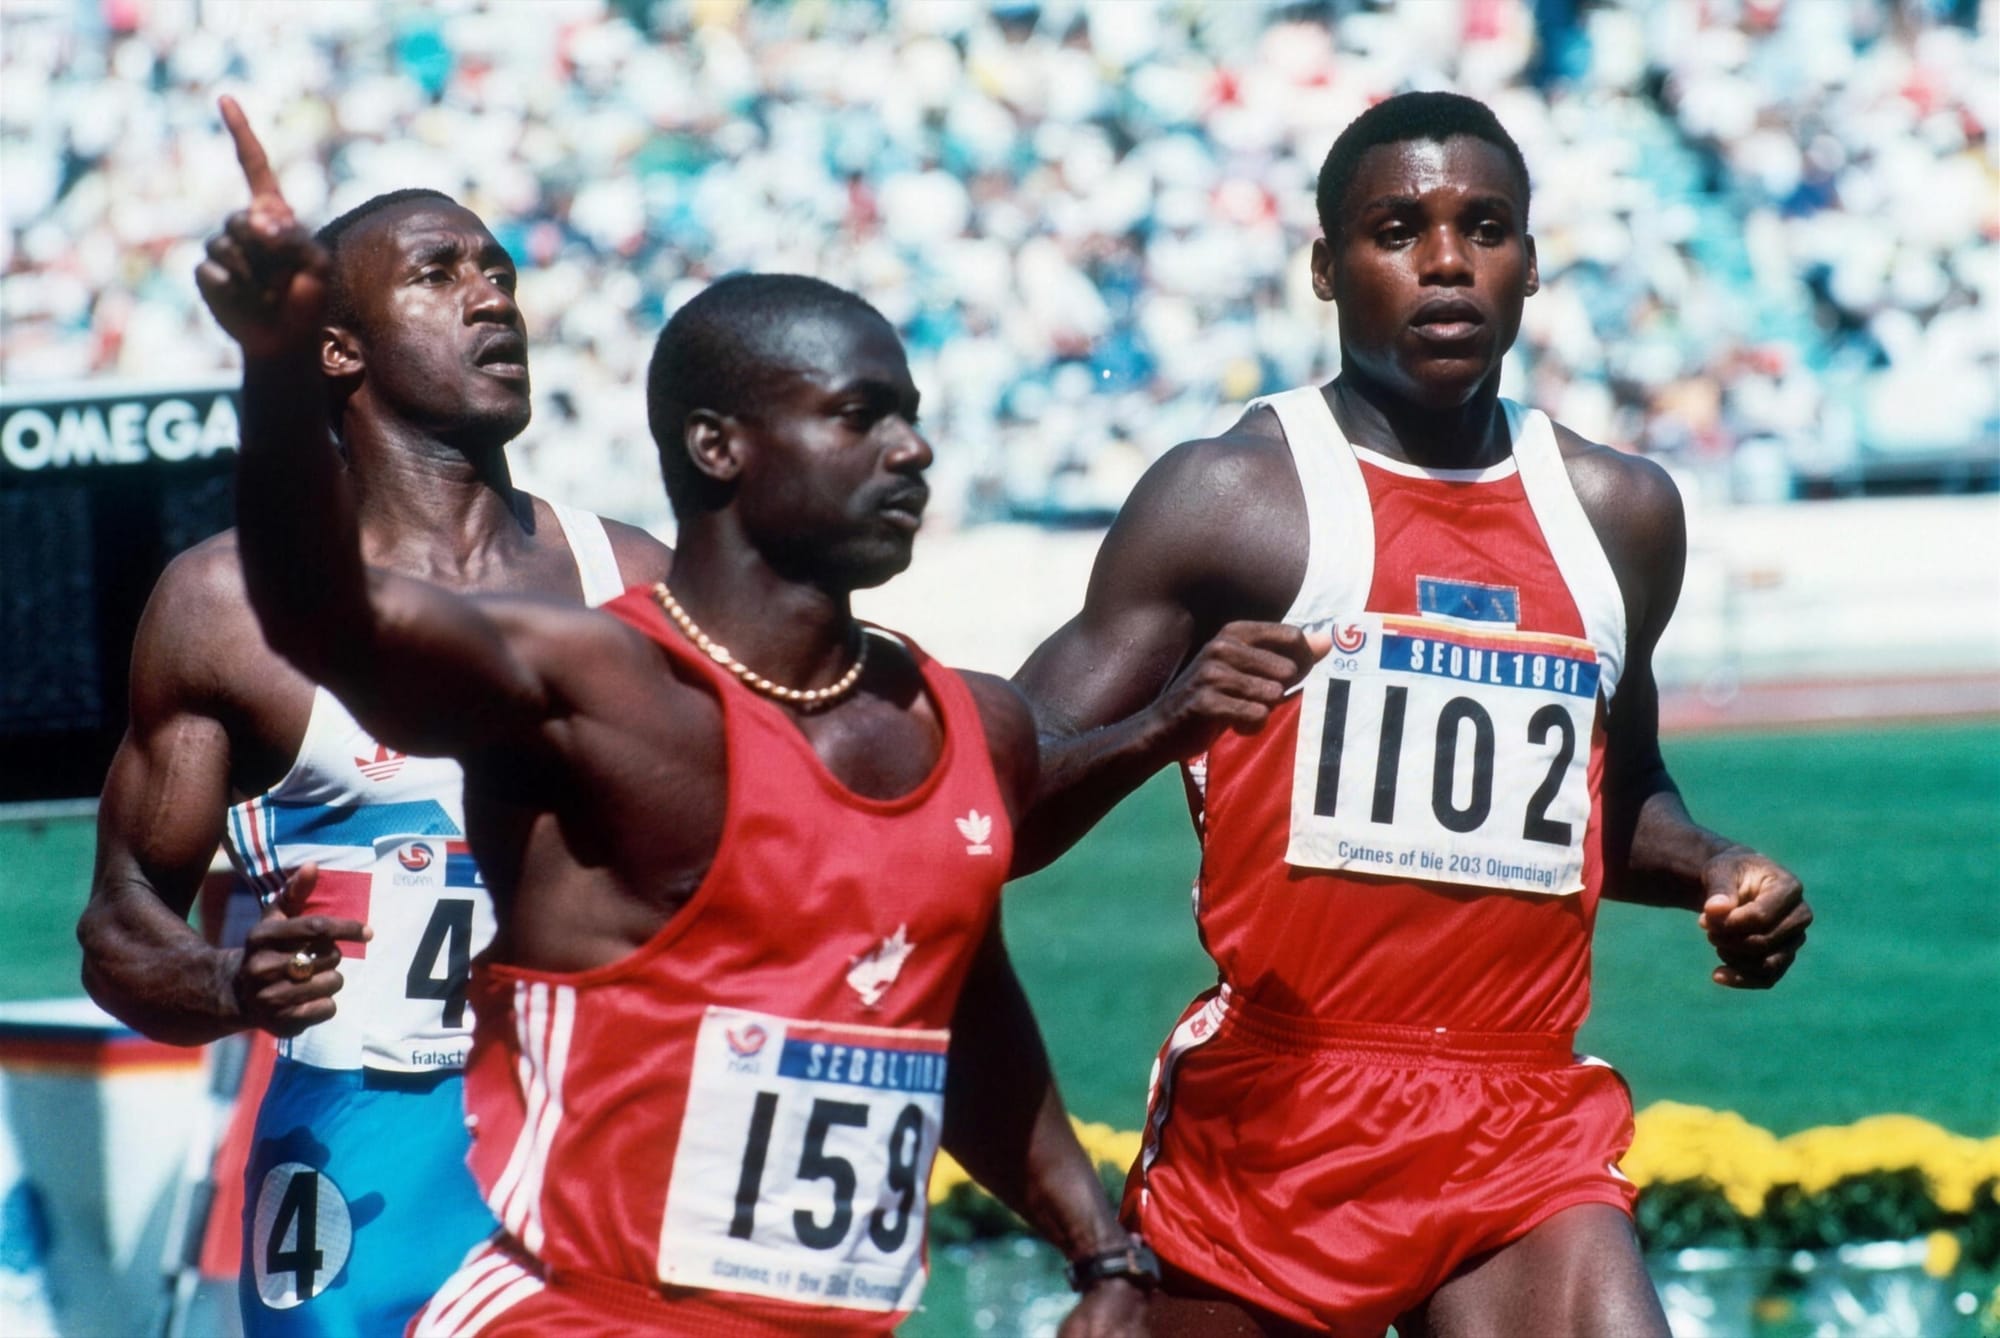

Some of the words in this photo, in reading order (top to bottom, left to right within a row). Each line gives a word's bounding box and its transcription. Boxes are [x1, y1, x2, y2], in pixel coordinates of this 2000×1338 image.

[2, 394, 240, 471] OMEGA
[1410, 639, 1502, 684] SEOUL
[1313, 678, 1576, 847] 1102
[1399, 850, 1416, 866] of
[406, 898, 475, 1028] 4
[266, 1171, 324, 1300] 4
[728, 1091, 923, 1253] 159
